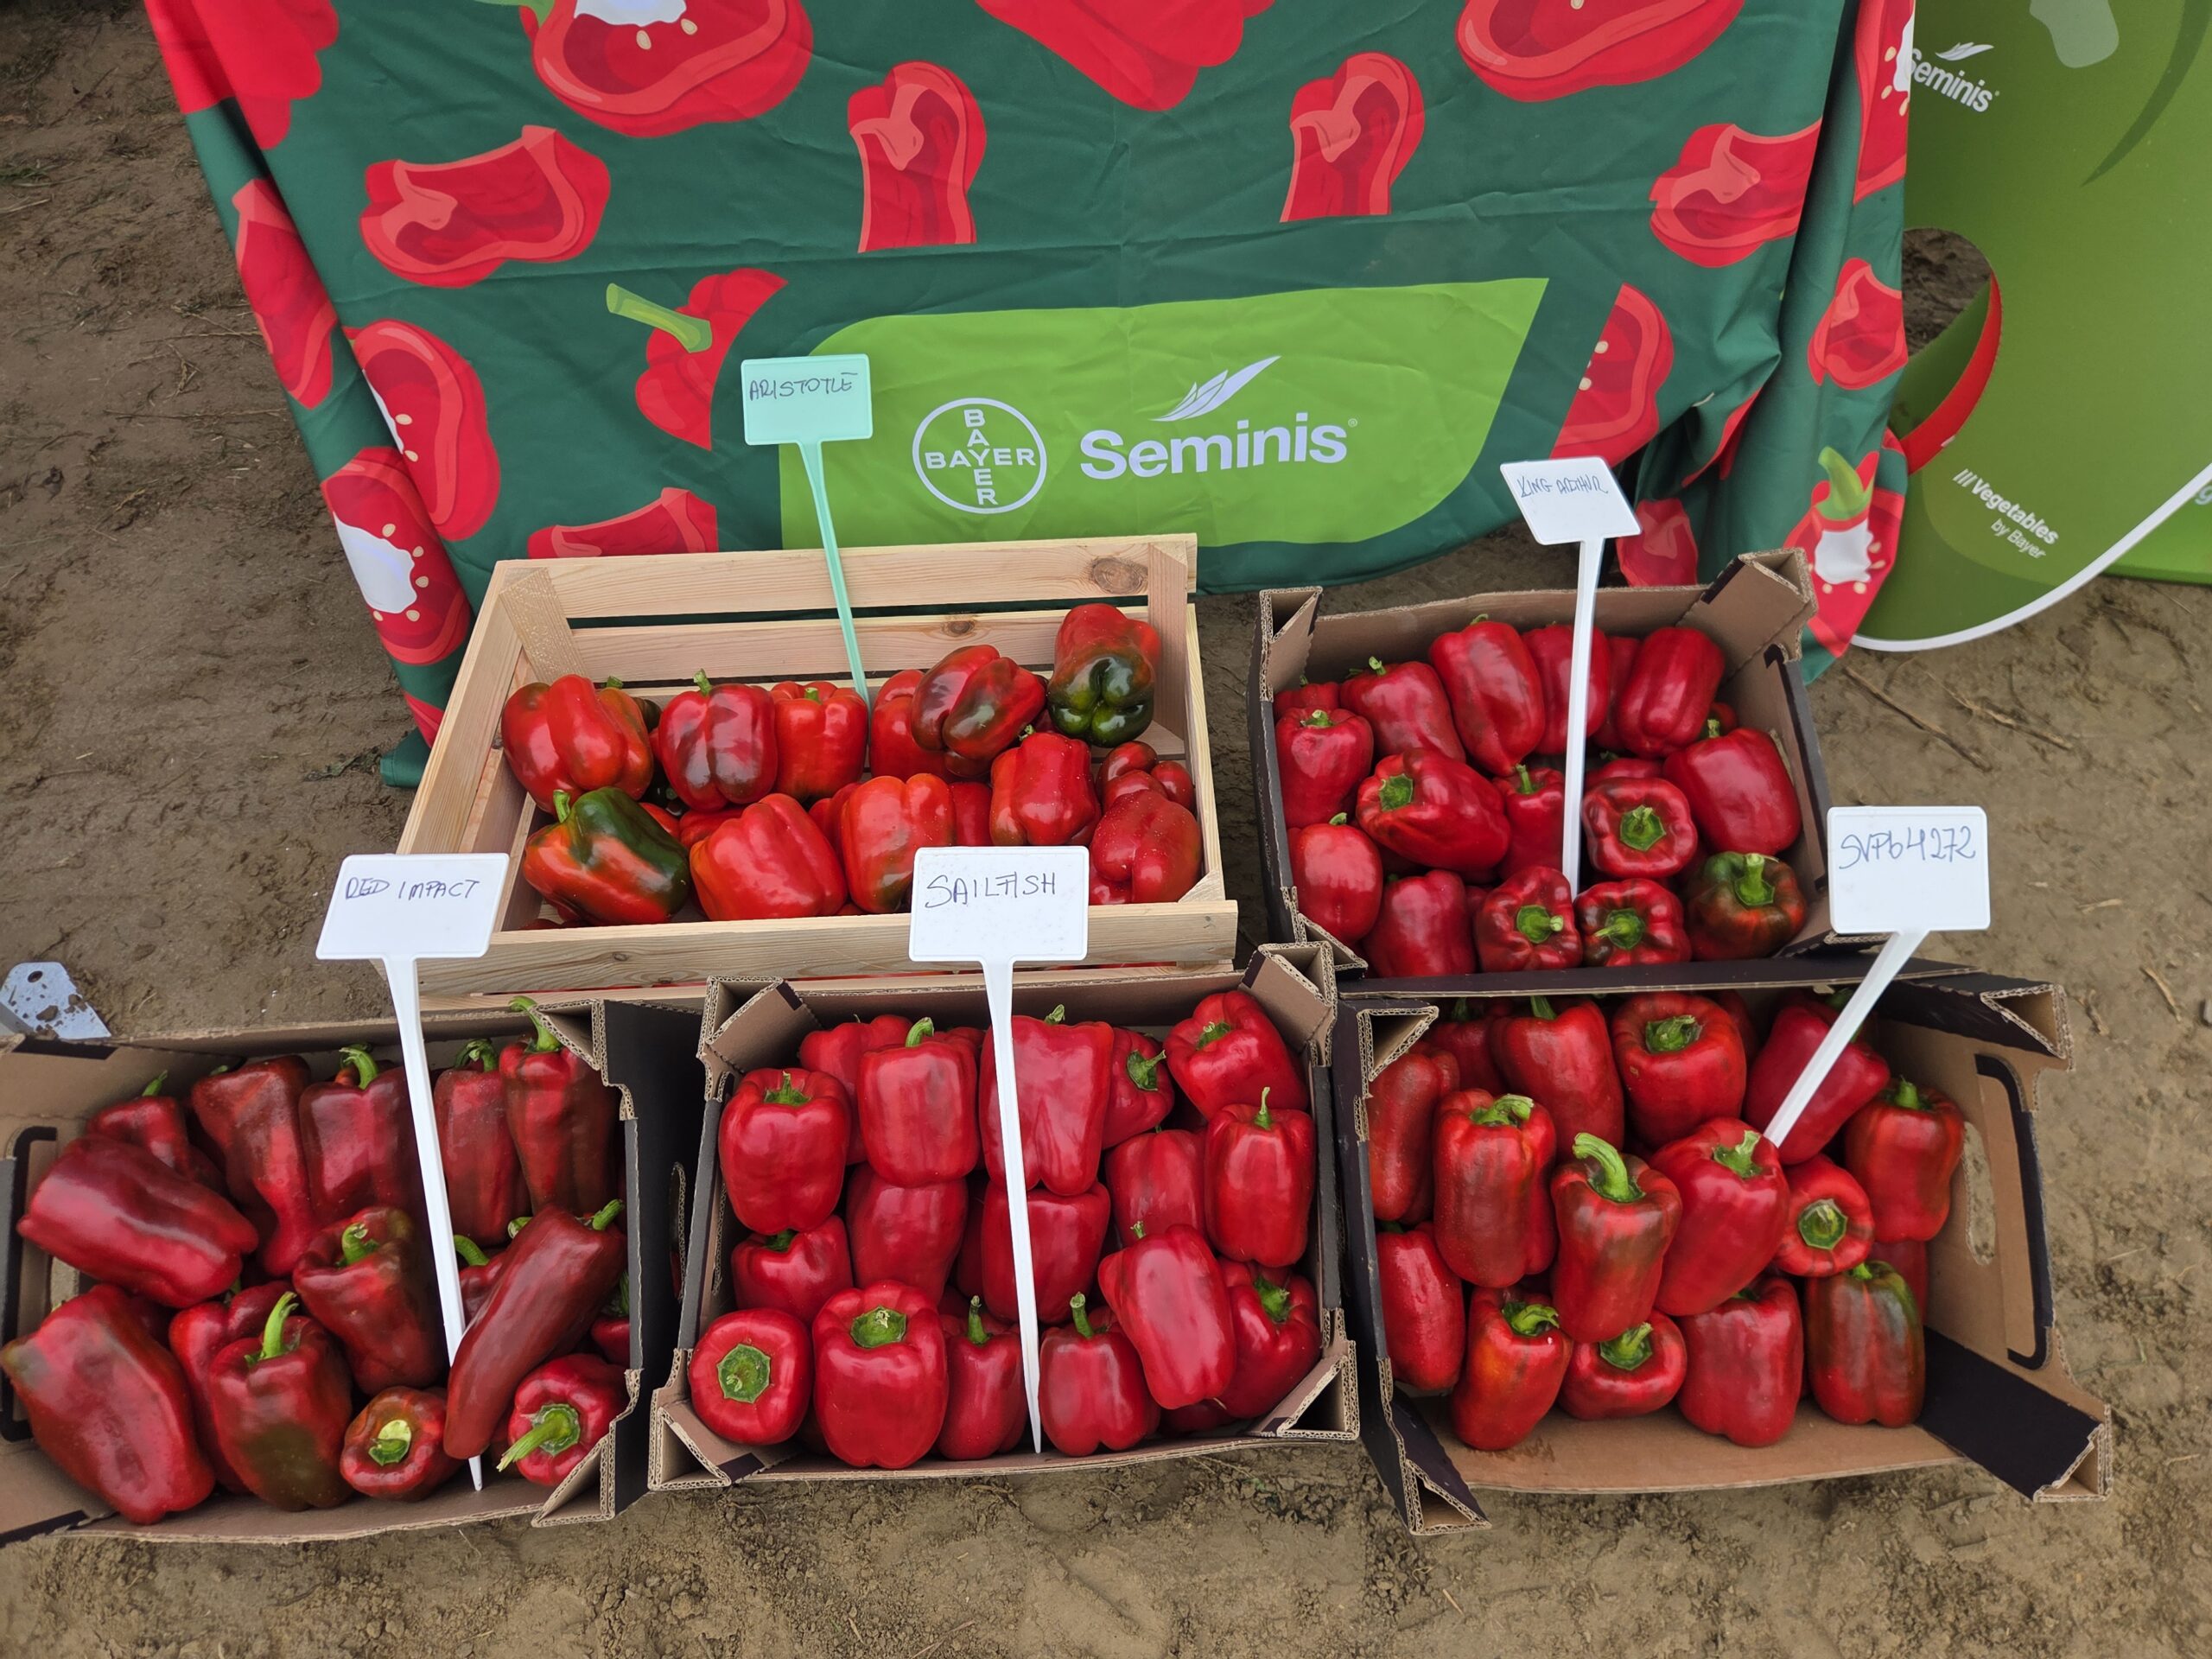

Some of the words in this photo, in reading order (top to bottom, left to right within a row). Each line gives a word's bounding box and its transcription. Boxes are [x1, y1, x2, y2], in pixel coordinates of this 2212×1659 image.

[749, 372, 857, 401] ARISTOTLE
[925, 448, 1036, 469] BAYER
[963, 409, 998, 505] BAYER
[1516, 476, 1553, 498] KING
[1556, 474, 1609, 495] ARTHUR
[1972, 478, 2058, 544] Vegetables
[1991, 518, 2011, 537] by
[2007, 529, 2046, 558] Bayer
[397, 880, 480, 900] IMPACT
[925, 871, 1056, 908] SAILFISH
